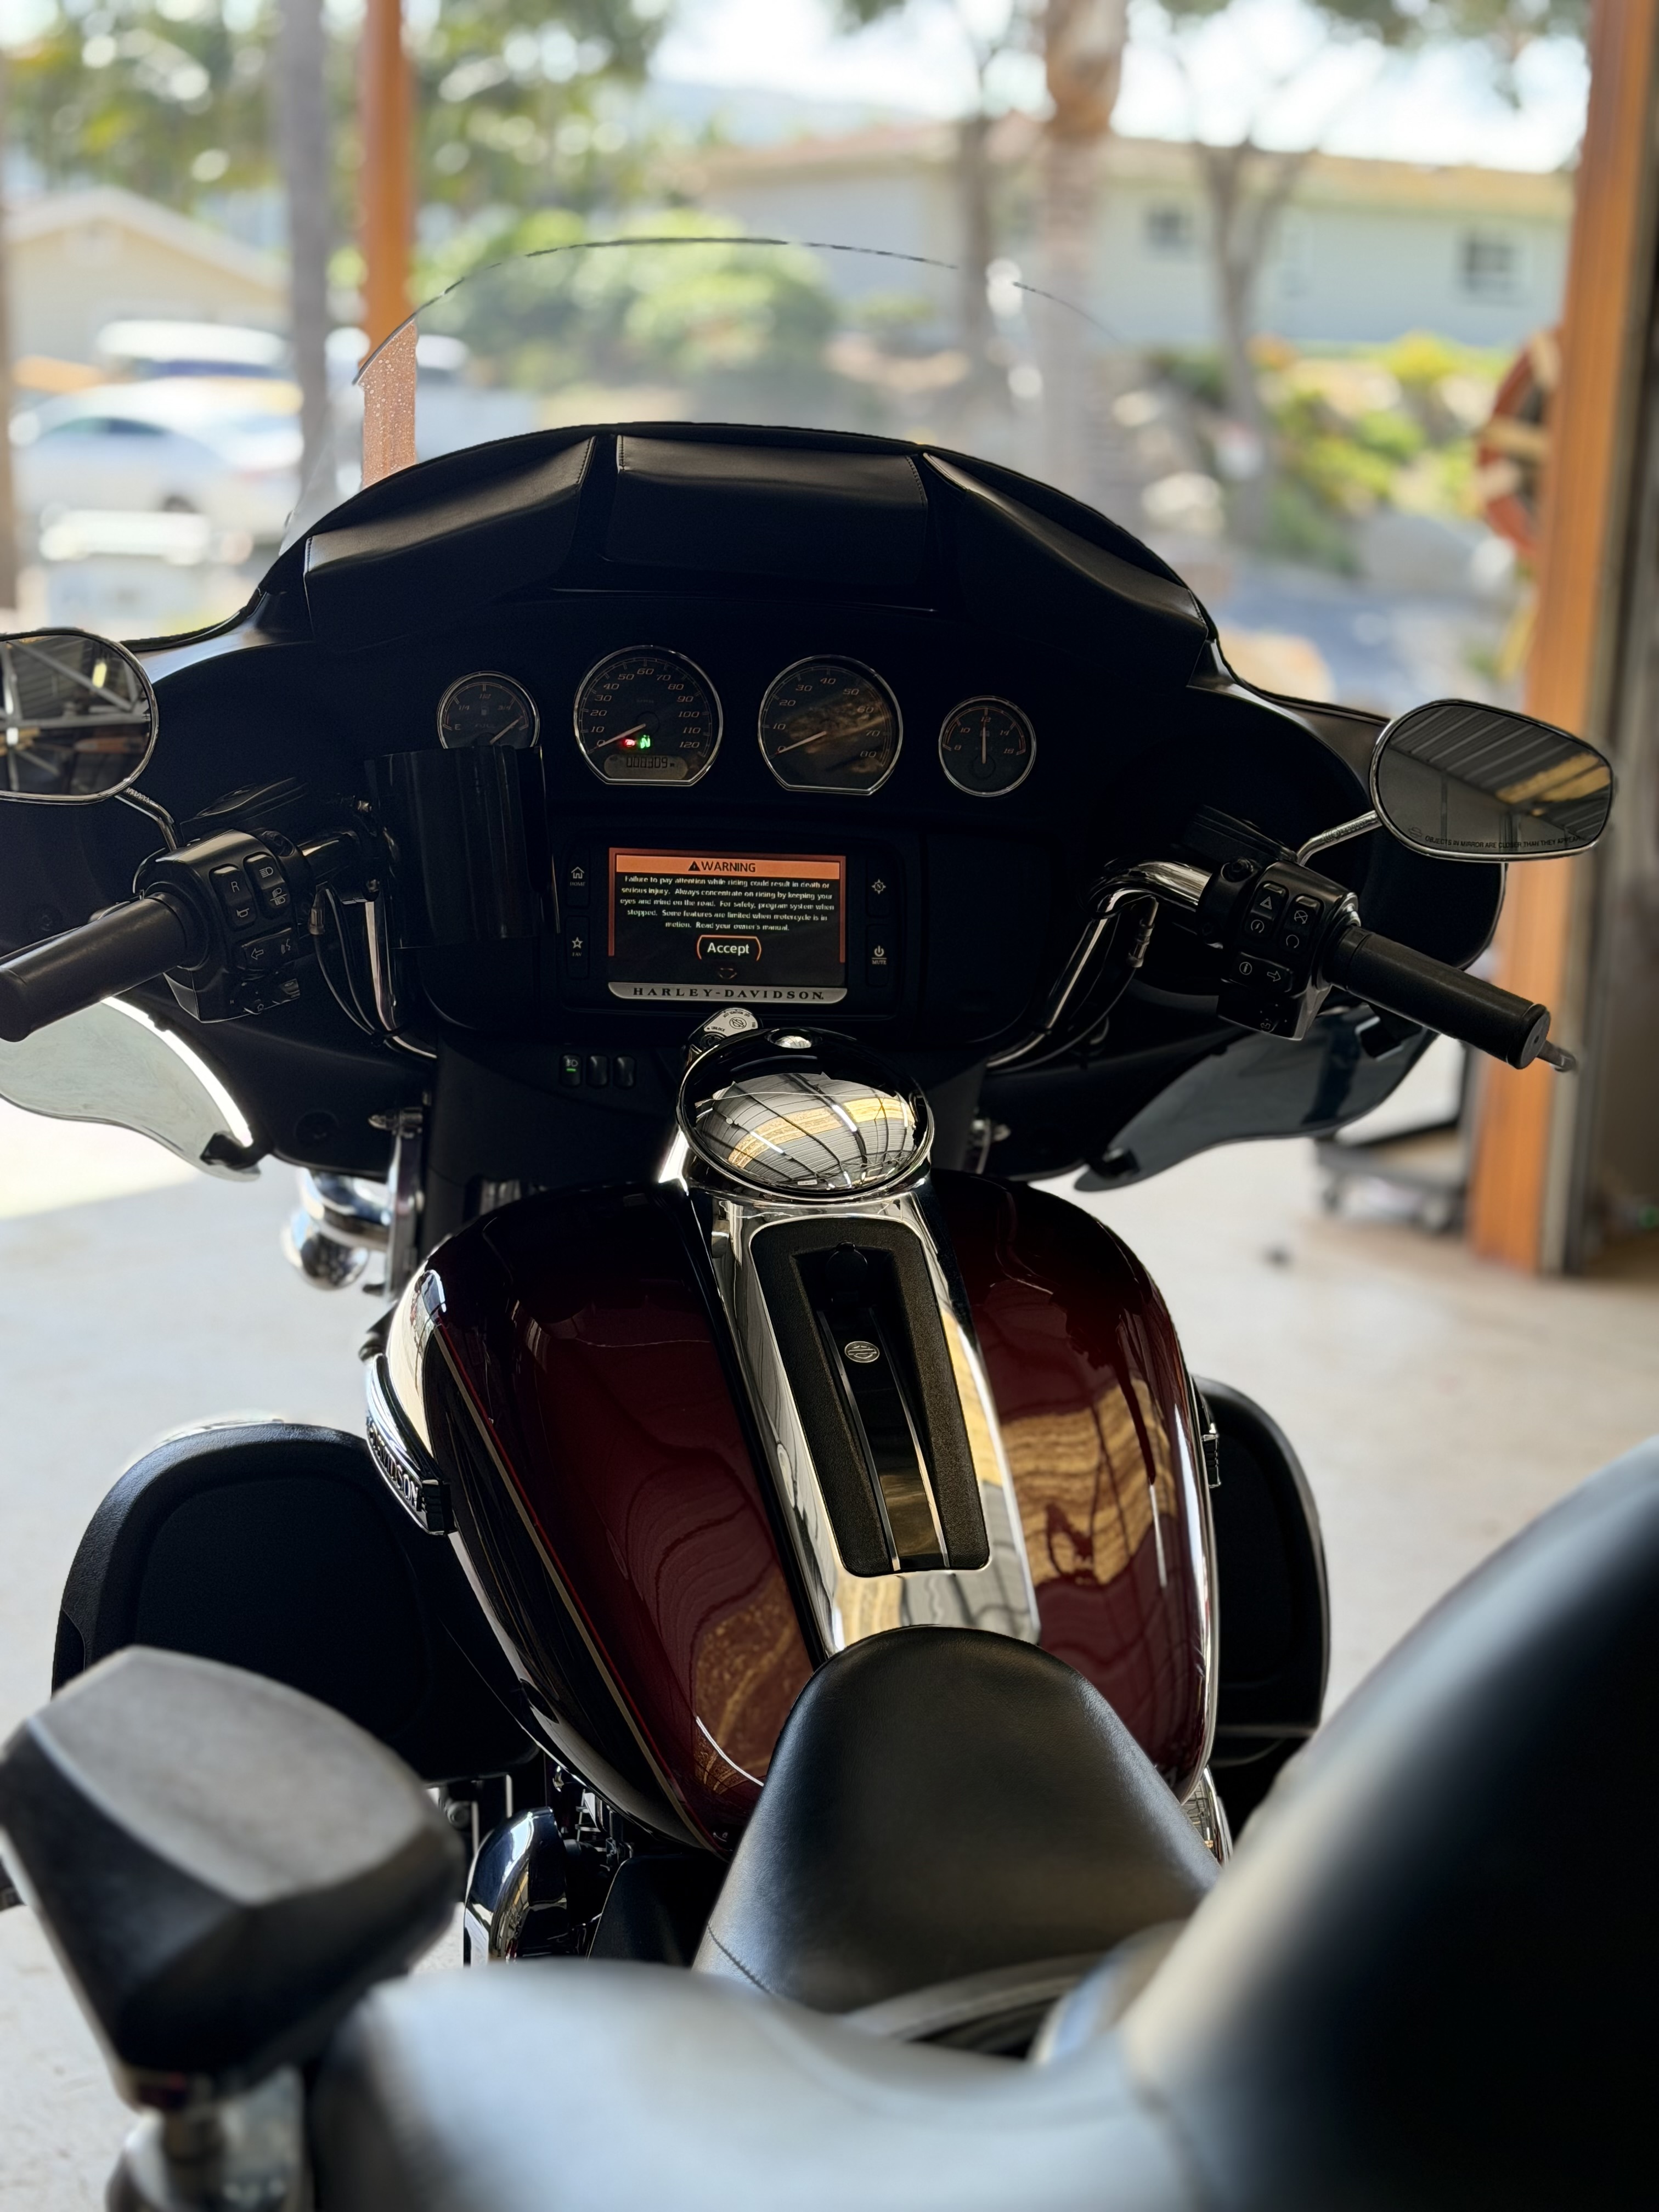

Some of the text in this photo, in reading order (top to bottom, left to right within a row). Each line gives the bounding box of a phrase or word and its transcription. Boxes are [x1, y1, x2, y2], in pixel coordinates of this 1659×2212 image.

[640, 737, 651, 749] N
[1425, 835, 1452, 846] OBJECTS
[701, 861, 756, 873] WARNING
[231, 881, 240, 893] R
[675, 888, 699, 896] Always
[788, 892, 815, 900] keeping
[774, 913, 811, 922] motorcycle
[707, 942, 750, 956] Accept
